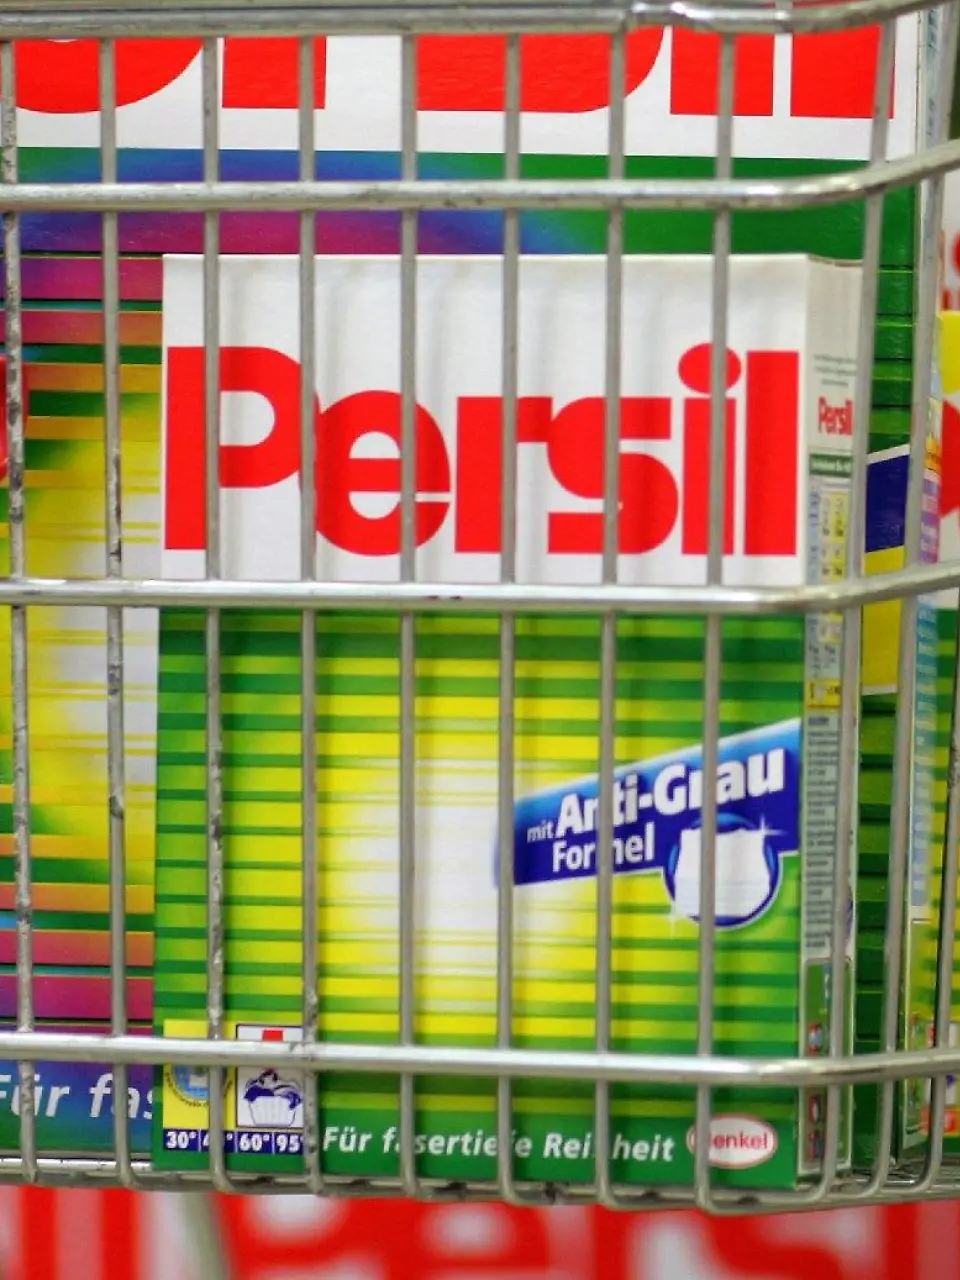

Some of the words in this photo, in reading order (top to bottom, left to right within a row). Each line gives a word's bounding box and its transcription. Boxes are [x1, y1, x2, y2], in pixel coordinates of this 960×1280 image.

[818, 396, 854, 436] Persil
[165, 342, 799, 557] Persil
[526, 819, 554, 843] mit
[323, 1126, 372, 1152] Für
[382, 1126, 533, 1158] fsertiee
[543, 1132, 675, 1162] Reiheit
[708, 1129, 768, 1149] enkel
